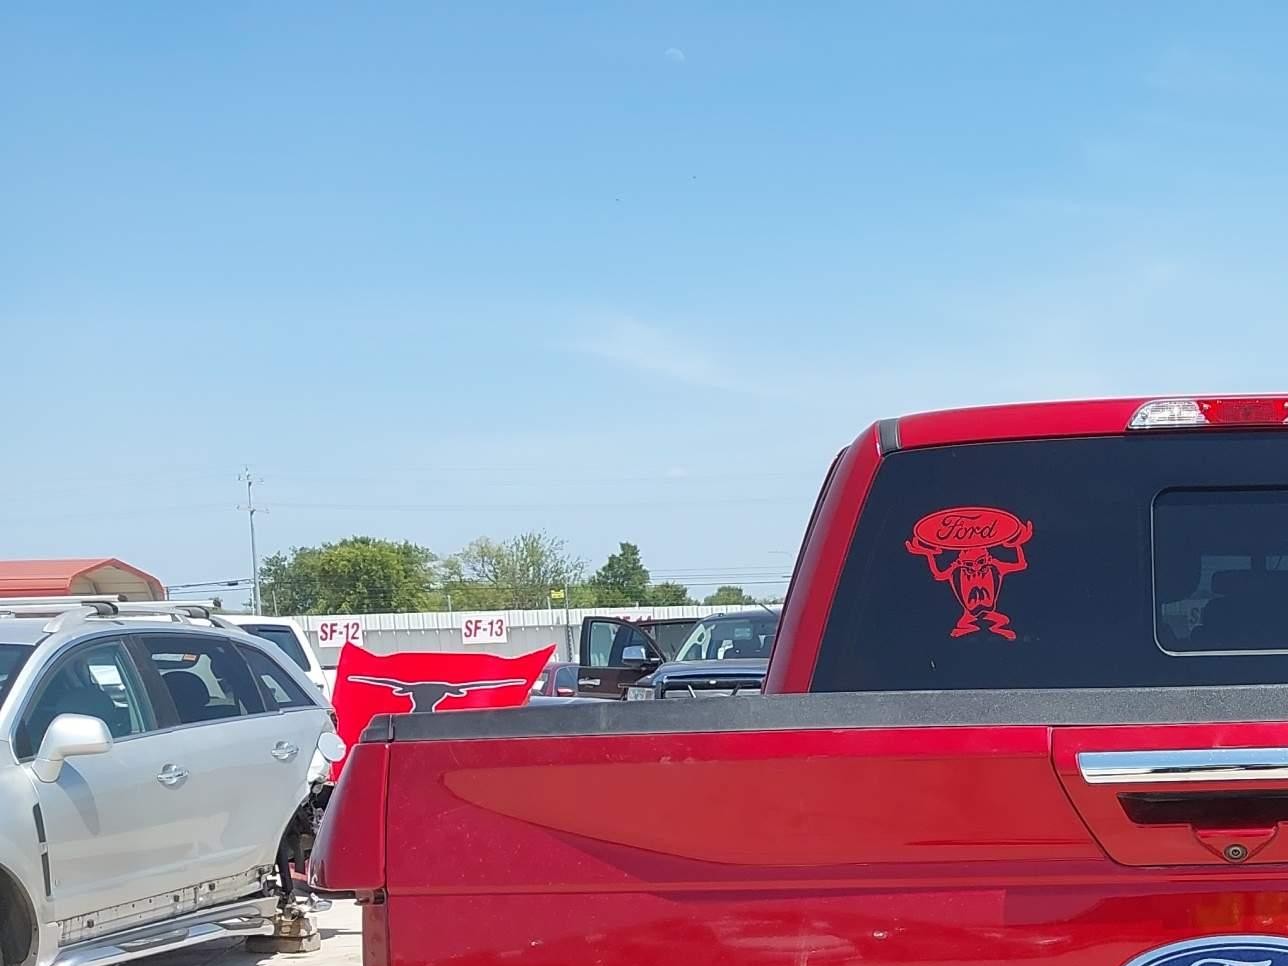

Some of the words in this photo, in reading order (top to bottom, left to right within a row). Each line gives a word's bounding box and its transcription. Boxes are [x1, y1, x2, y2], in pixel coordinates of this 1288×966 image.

[936, 514, 998, 540] Ford
[319, 622, 360, 642] SF-12
[464, 619, 504, 638] SF-13
